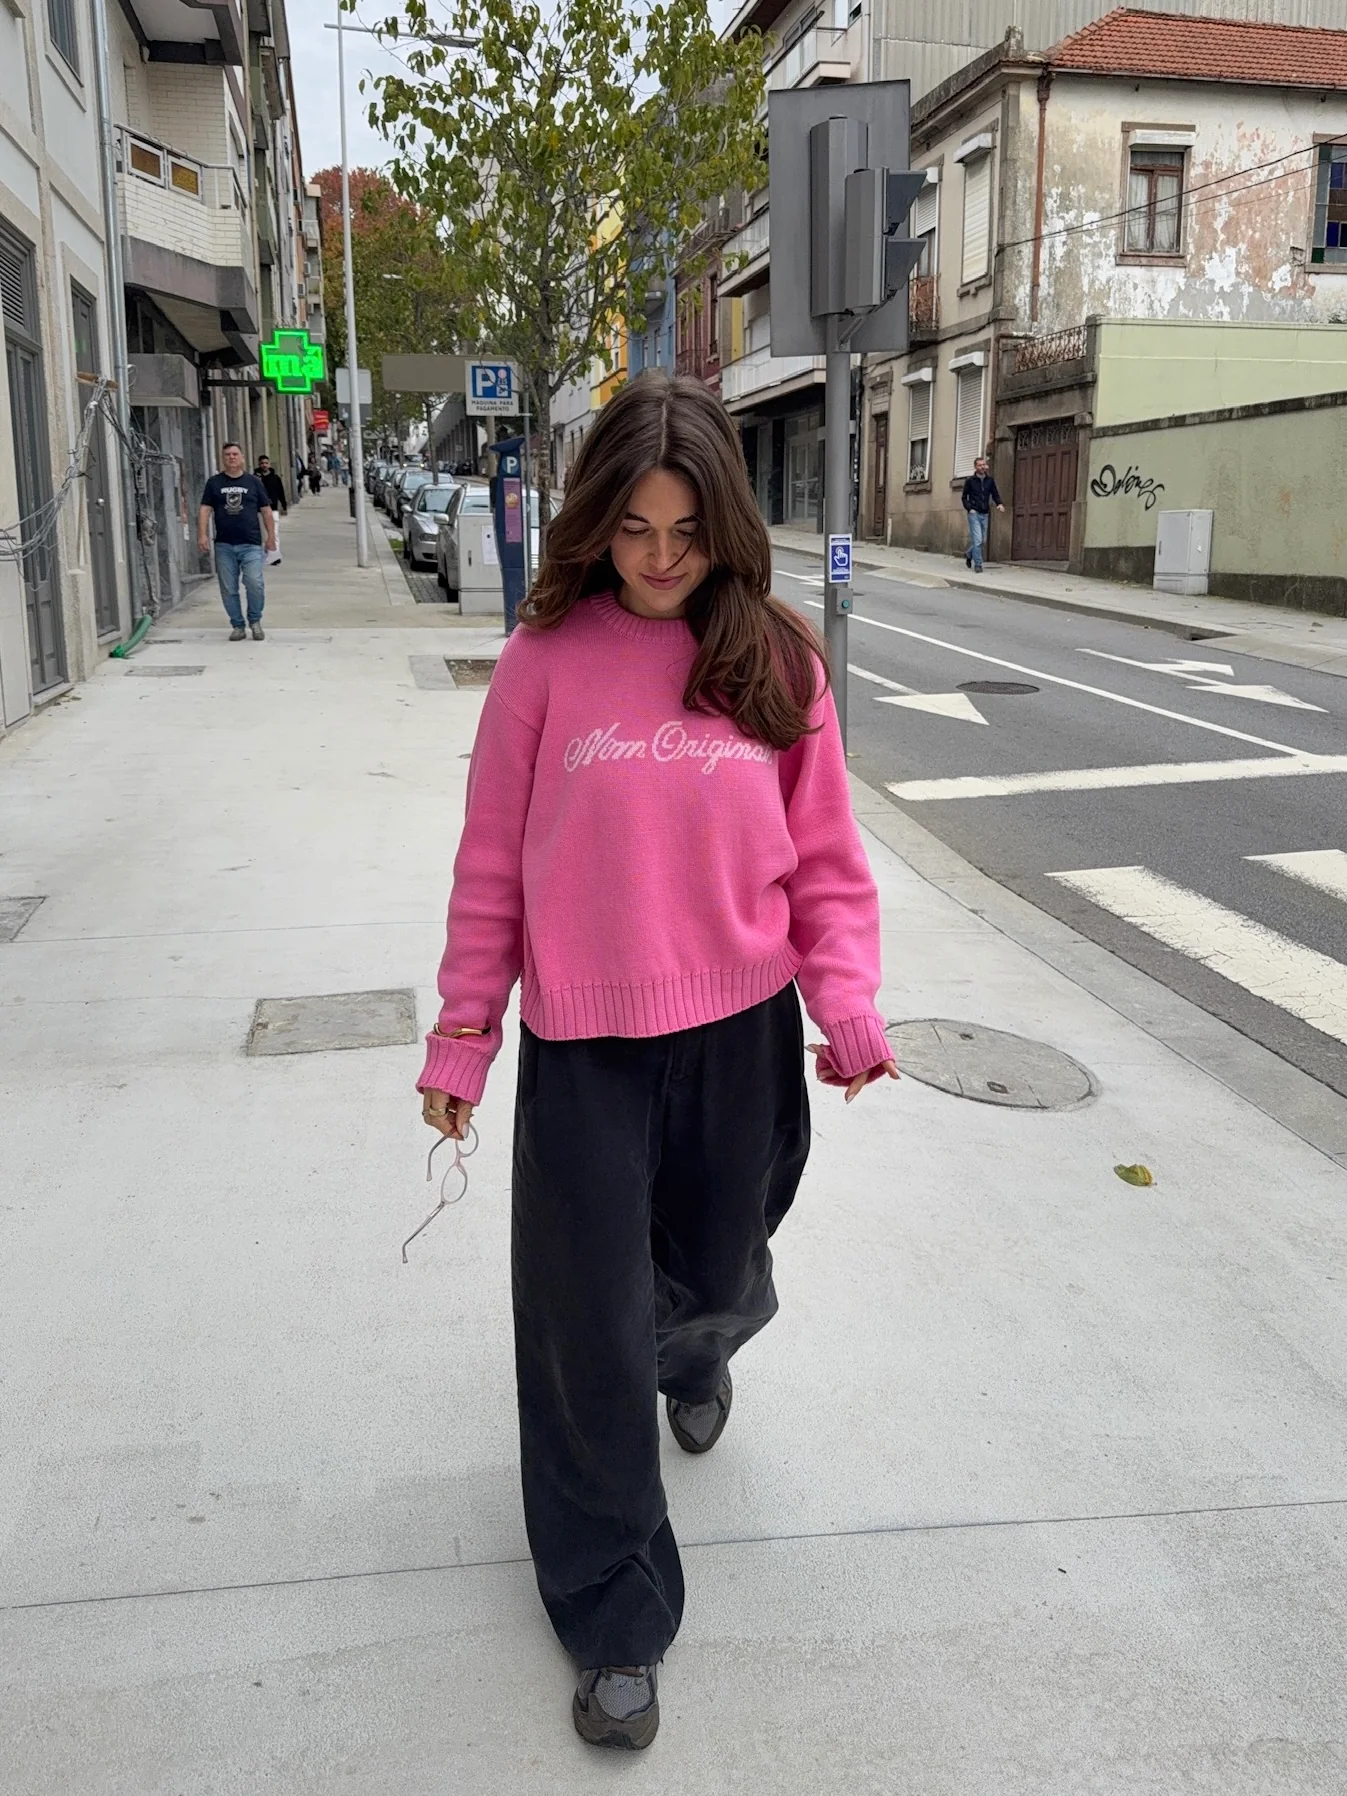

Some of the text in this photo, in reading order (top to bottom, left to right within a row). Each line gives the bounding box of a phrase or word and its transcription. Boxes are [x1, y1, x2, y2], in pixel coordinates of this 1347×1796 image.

[475, 367, 496, 397] P
[506, 456, 518, 473] P
[220, 486, 249, 494] RUGBY
